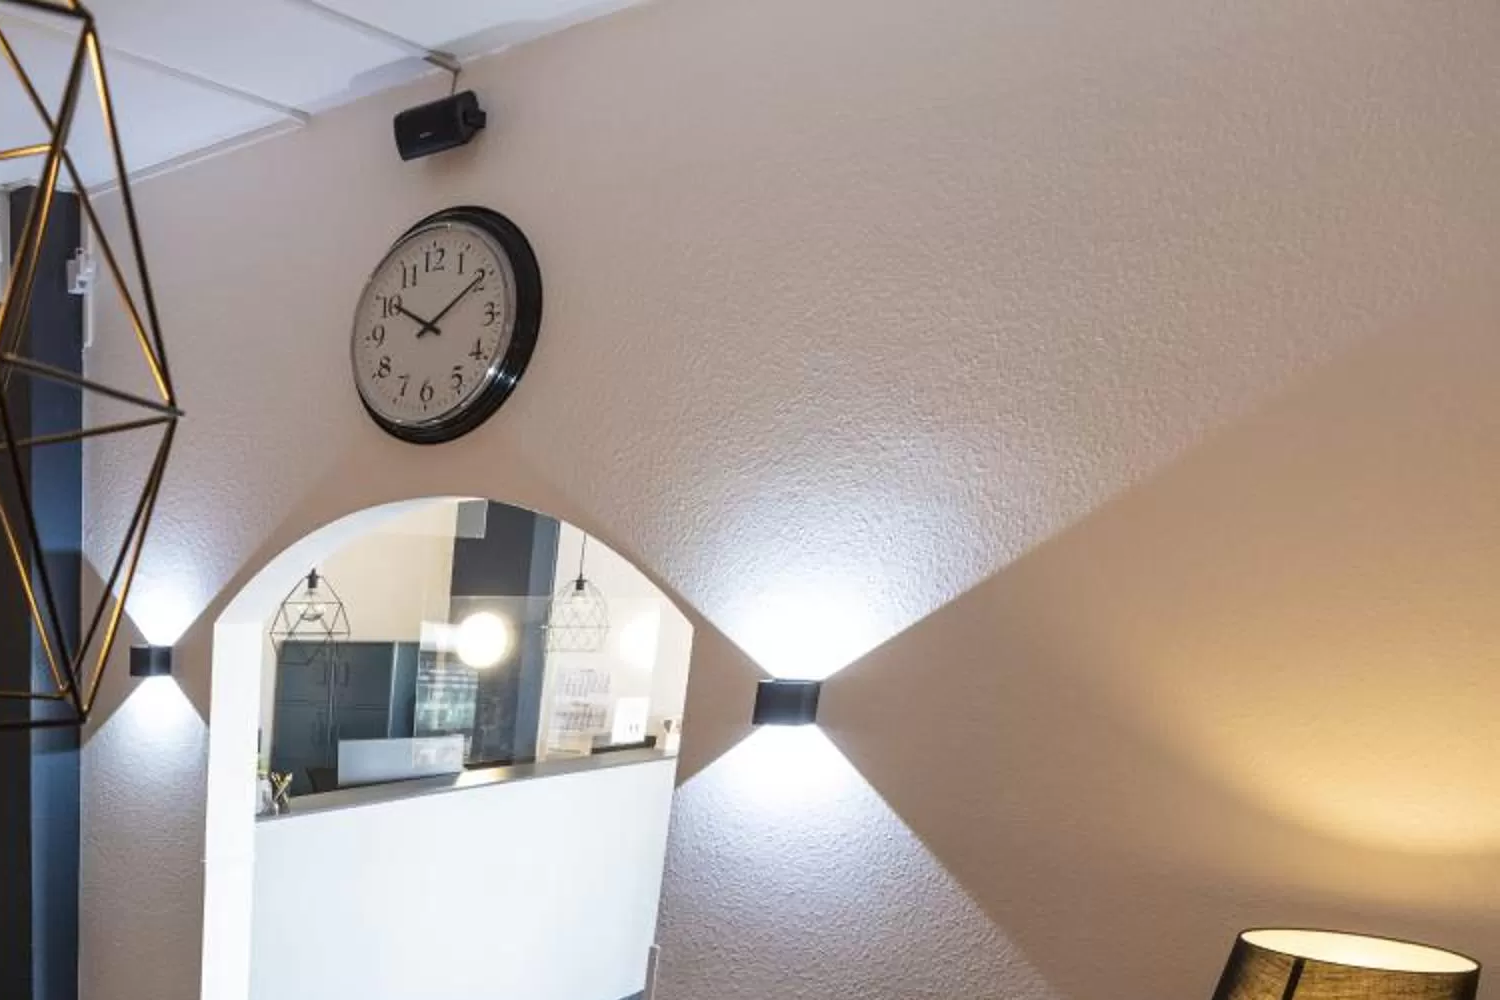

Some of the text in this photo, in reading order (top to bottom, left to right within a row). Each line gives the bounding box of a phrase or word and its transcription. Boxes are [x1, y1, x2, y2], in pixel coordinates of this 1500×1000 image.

[424, 248, 445, 272] 12
[400, 261, 417, 289] 11
[473, 268, 485, 292] 2
[381, 295, 402, 318] 10
[483, 301, 496, 327] 3
[372, 324, 385, 347] 9
[468, 337, 484, 361] 4
[378, 356, 392, 379] 8
[451, 365, 464, 391] 5
[397, 375, 410, 396] 7
[419, 380, 434, 402] 6
